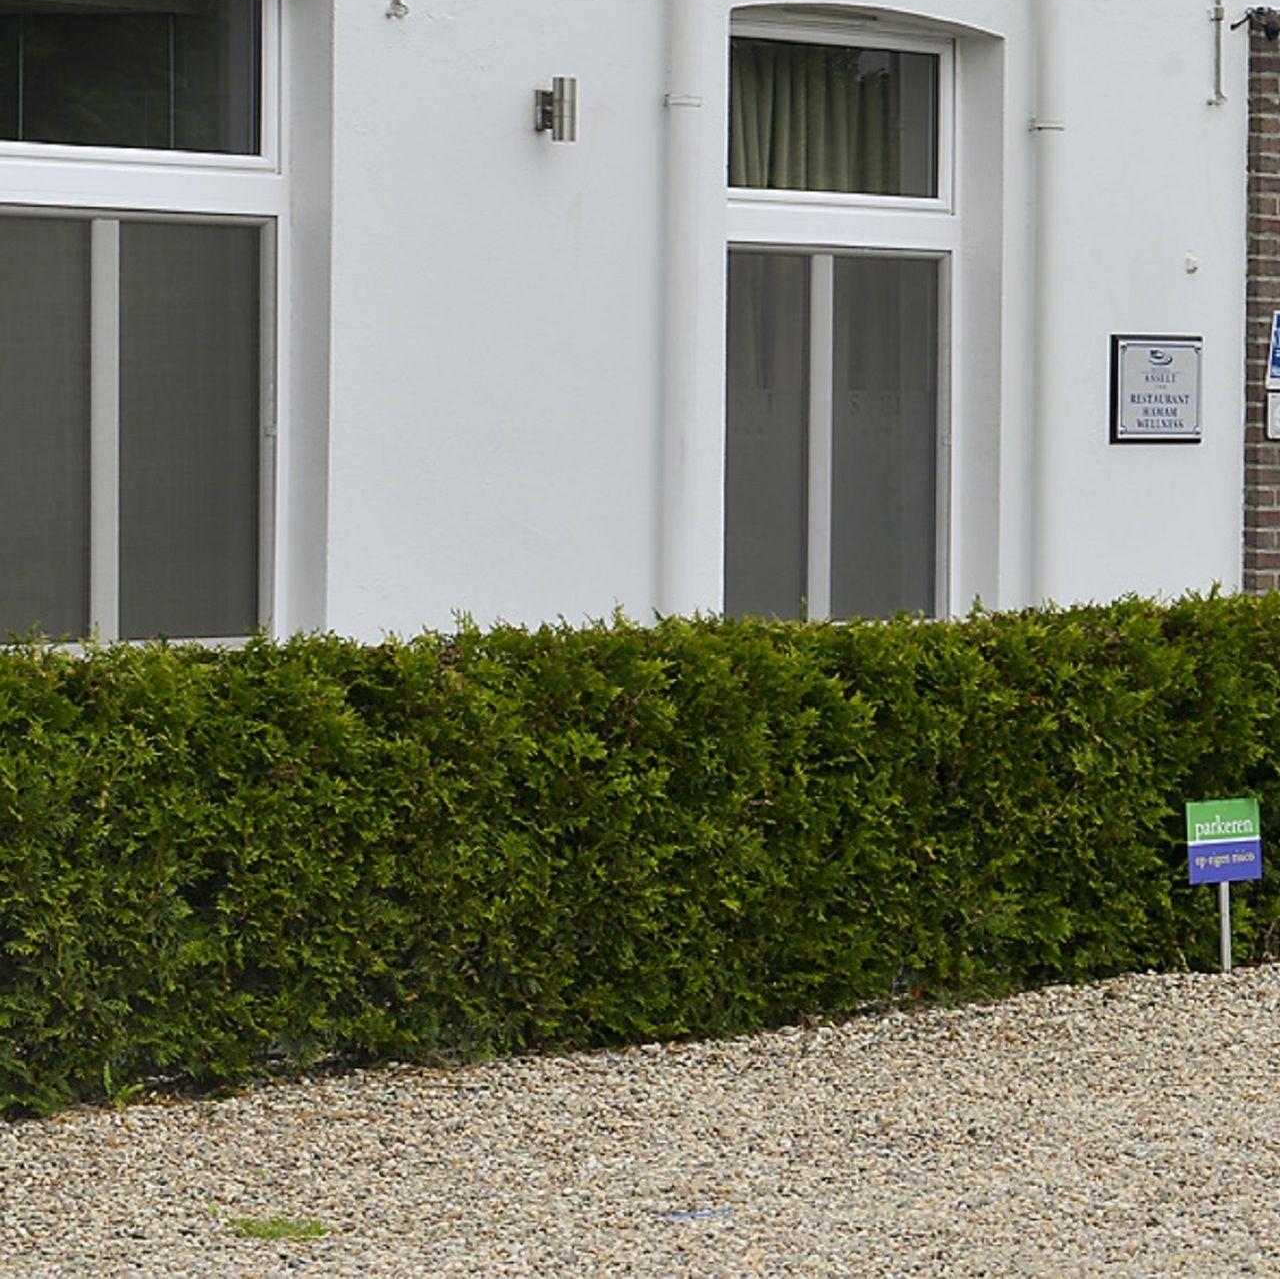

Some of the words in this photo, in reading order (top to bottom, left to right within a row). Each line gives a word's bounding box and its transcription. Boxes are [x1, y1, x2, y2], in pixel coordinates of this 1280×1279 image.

[1130, 393, 1189, 405] RESTAURANT
[1137, 418, 1184, 428] WELLNESS
[1194, 815, 1254, 840] parkeren
